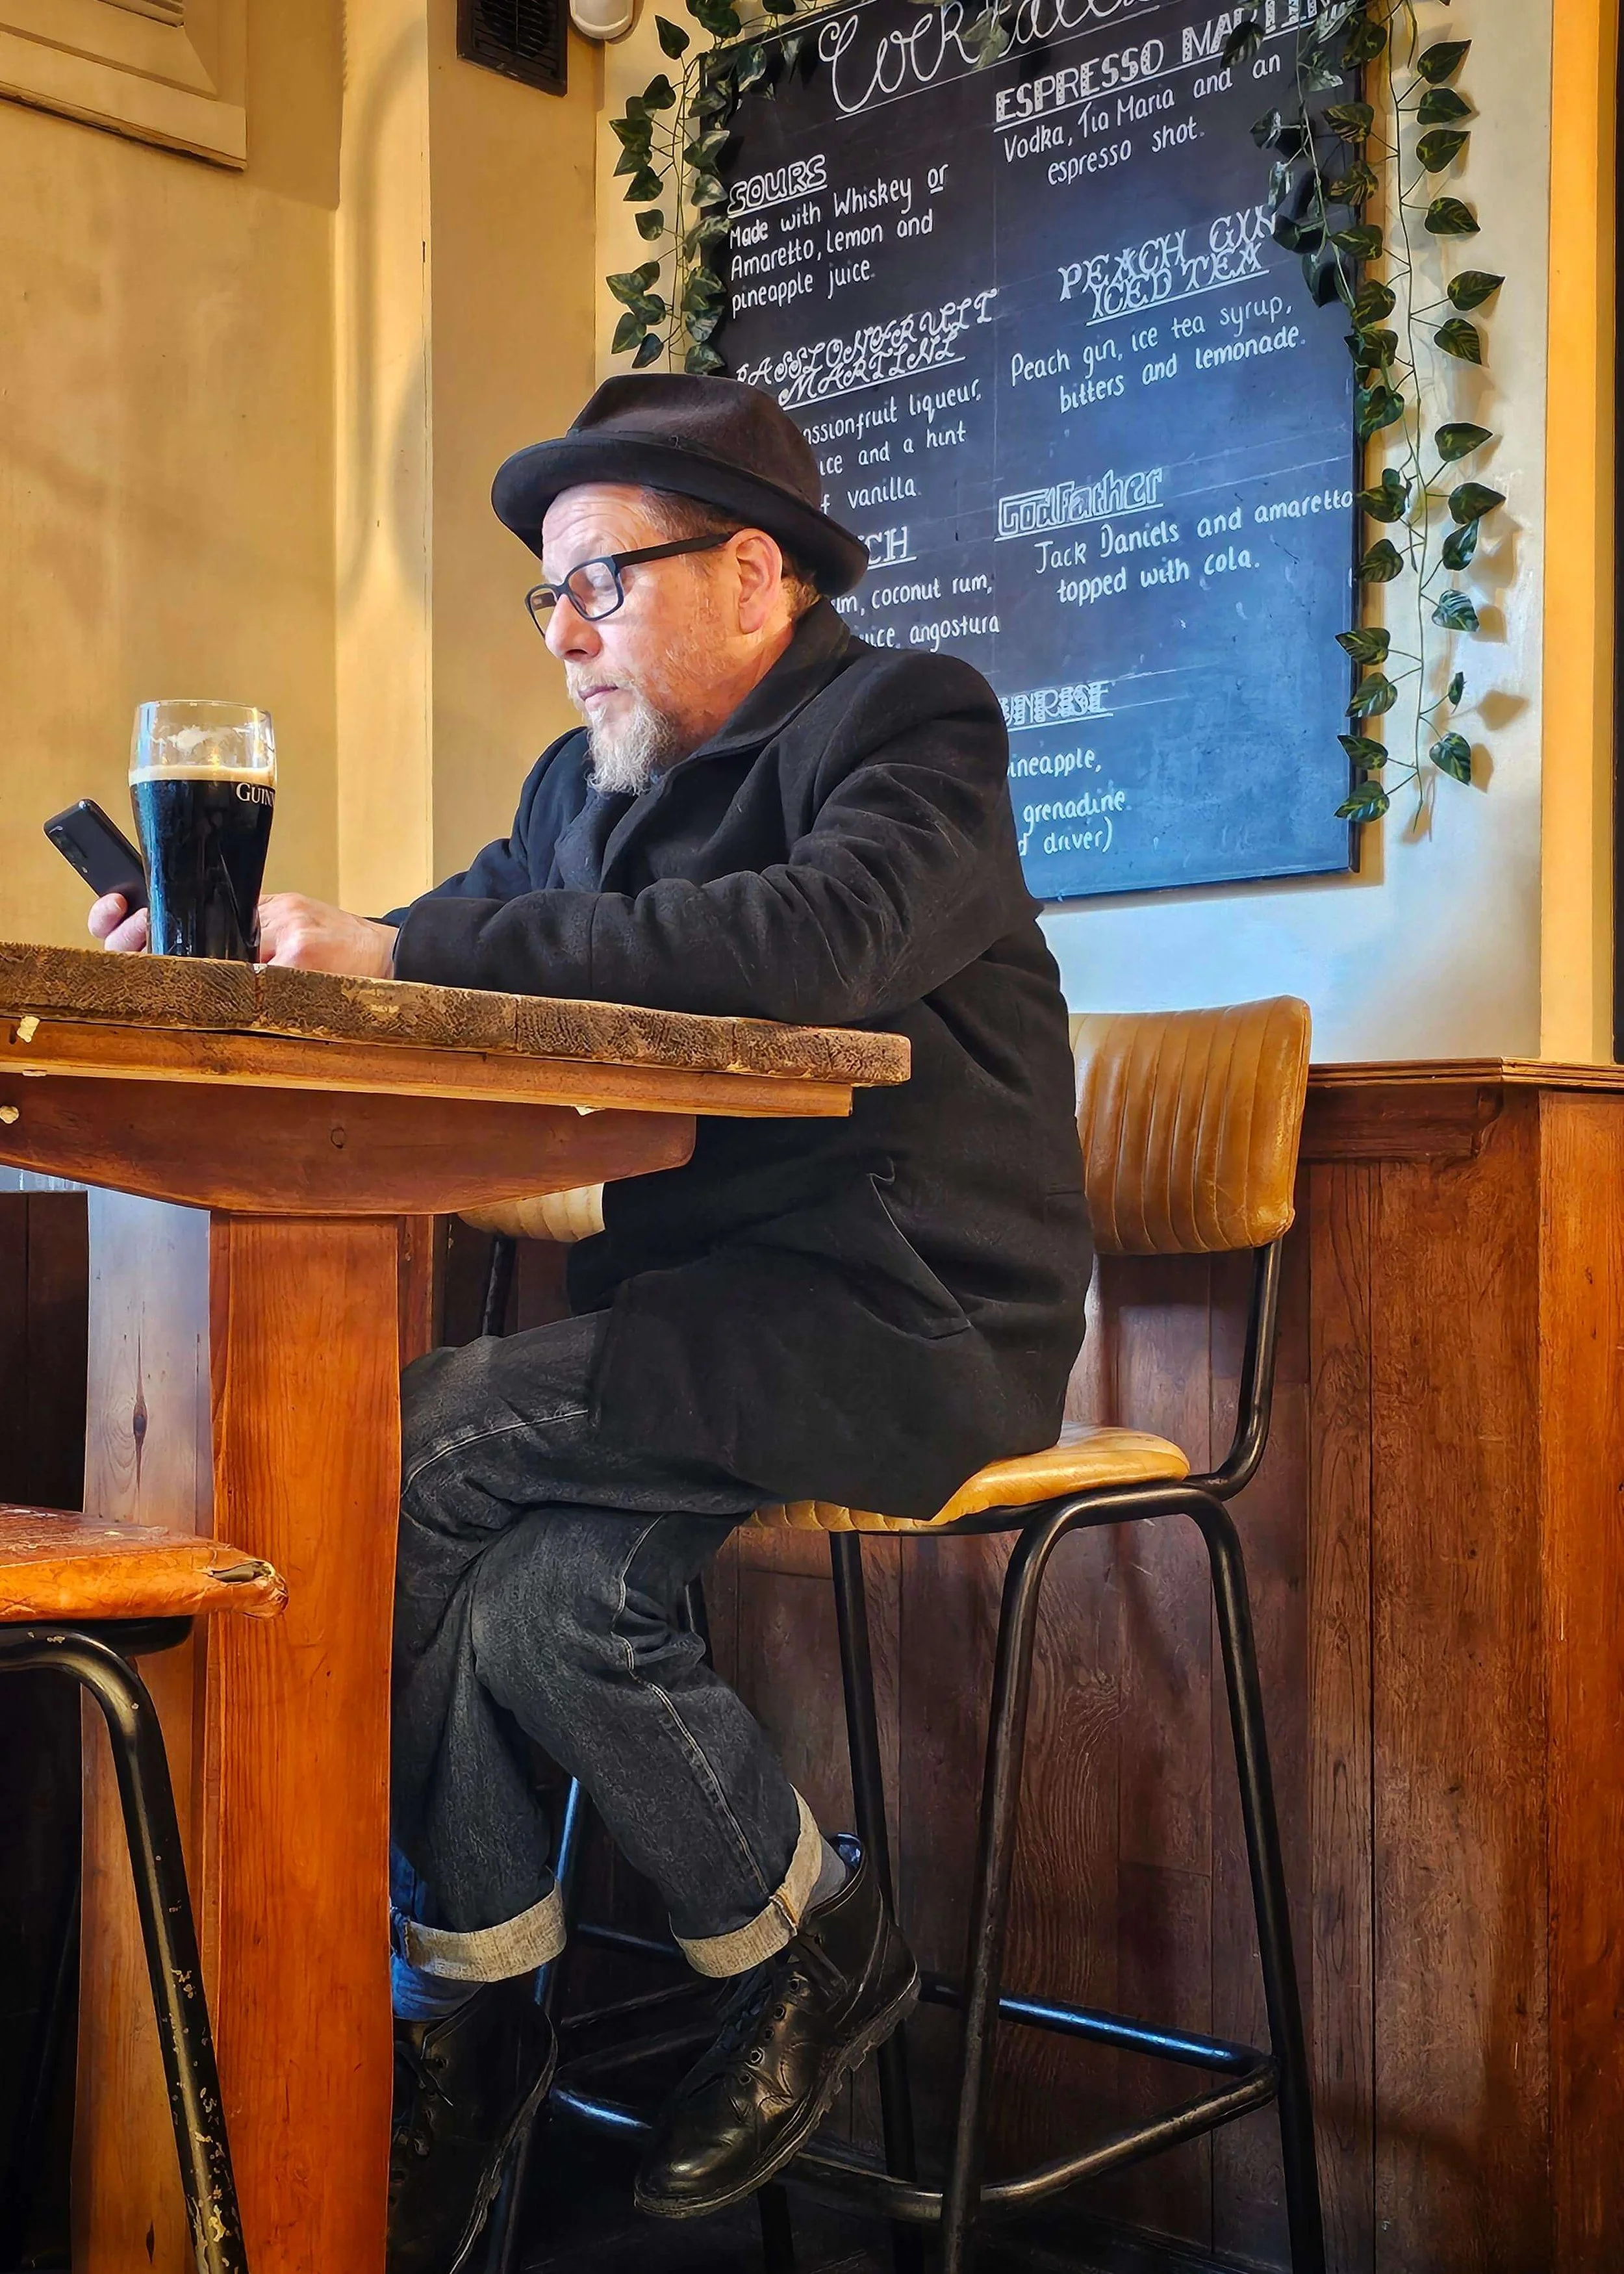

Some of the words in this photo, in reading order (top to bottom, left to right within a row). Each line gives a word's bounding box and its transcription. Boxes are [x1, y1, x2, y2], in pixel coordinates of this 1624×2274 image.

[995, 40, 1164, 122] ESPRESSO
[1004, 123, 1072, 163] Vodka,
[1078, 101, 1110, 138] Tia
[1117, 84, 1175, 126] Maria
[1193, 67, 1234, 99] and
[1252, 54, 1281, 79] an
[728, 154, 828, 215] SOURS
[1048, 140, 1132, 186] espresso
[730, 219, 768, 249] Made
[780, 201, 821, 232] with
[833, 177, 912, 218] Whiskey
[927, 164, 949, 190] or
[731, 238, 822, 281] Amaretto,
[826, 224, 883, 253] lemon
[896, 208, 933, 238] and
[1058, 229, 1186, 301] PEACH
[1210, 205, 1276, 254] GIN
[731, 272, 813, 320] pineapple
[1093, 267, 1173, 318] ICED
[1180, 242, 1263, 292] TEA
[778, 329, 958, 407] MARTINI
[1011, 348, 1071, 387] Peach
[1131, 326, 1158, 352] ice
[1171, 315, 1206, 339] tea
[1219, 296, 1293, 338] syrup,
[1059, 374, 1125, 415] bitters
[1141, 353, 1178, 387] and
[858, 440, 891, 466] and
[903, 437, 915, 454] a
[926, 420, 967, 448] hint
[1034, 541, 1087, 575] Jack
[1100, 520, 1180, 559] Daniels
[1197, 507, 1243, 539] and
[1254, 490, 1354, 524] amaretto
[871, 577, 941, 610] coconut
[952, 574, 993, 595] rum,
[1056, 568, 1128, 608] topped
[1140, 556, 1190, 589] with
[1203, 545, 1262, 576] cola.
[909, 615, 1001, 654] angostura
[1007, 747, 1102, 778] ineapple,
[1043, 816, 1113, 854] driver)
